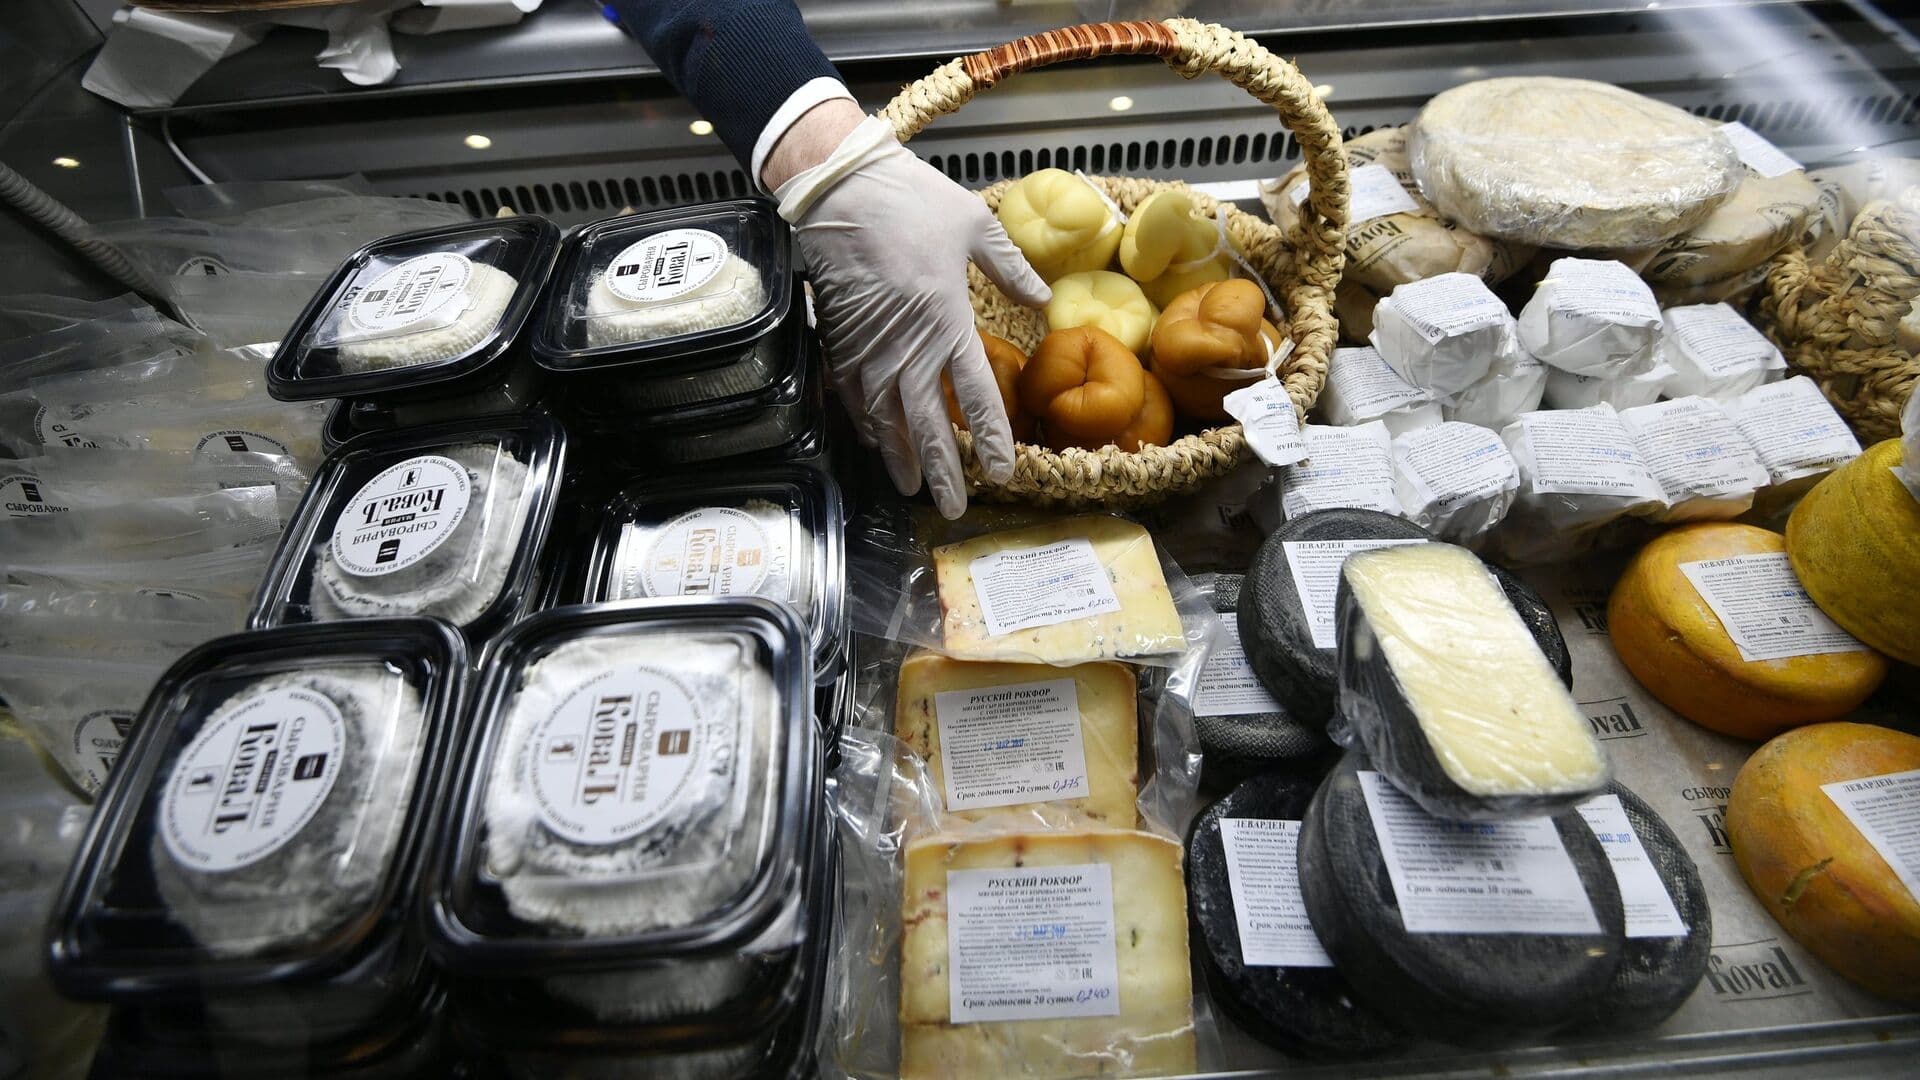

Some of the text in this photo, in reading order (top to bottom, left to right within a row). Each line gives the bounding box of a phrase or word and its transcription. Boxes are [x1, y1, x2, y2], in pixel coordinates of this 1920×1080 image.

[637, 245, 657, 291] СЫРОВАРНЯ
[1539, 478, 1559, 487] Срок
[1600, 479, 1610, 487] 10
[1611, 480, 1635, 489] суток
[352, 520, 438, 545] СЫРОВАРНЯ
[1000, 544, 1071, 561] РУССКИЙ РОКФОР
[1295, 542, 1345, 551] ЛЕВАРДЕН
[998, 606, 1086, 628] Срок годности 20 суток
[1201, 682, 1254, 691] рок годности
[970, 687, 1051, 704] РУССКИЙ РОКФОР
[632, 690, 660, 801] СЫРОВАРНЯ
[261, 716, 305, 828] СЫРОВАРНЯ
[957, 784, 1051, 801] Срок годности 20 суток
[1234, 820, 1286, 831] ЛЕВАРДЕН
[988, 875, 1083, 889] РУССКИЙ РОКФОР
[1407, 883, 1432, 896] Срок
[1437, 885, 1484, 894] годности
[1501, 886, 1533, 896] суток
[1250, 919, 1312, 931] Срок годност
[963, 995, 1075, 1009] Срок годности 20 суток
